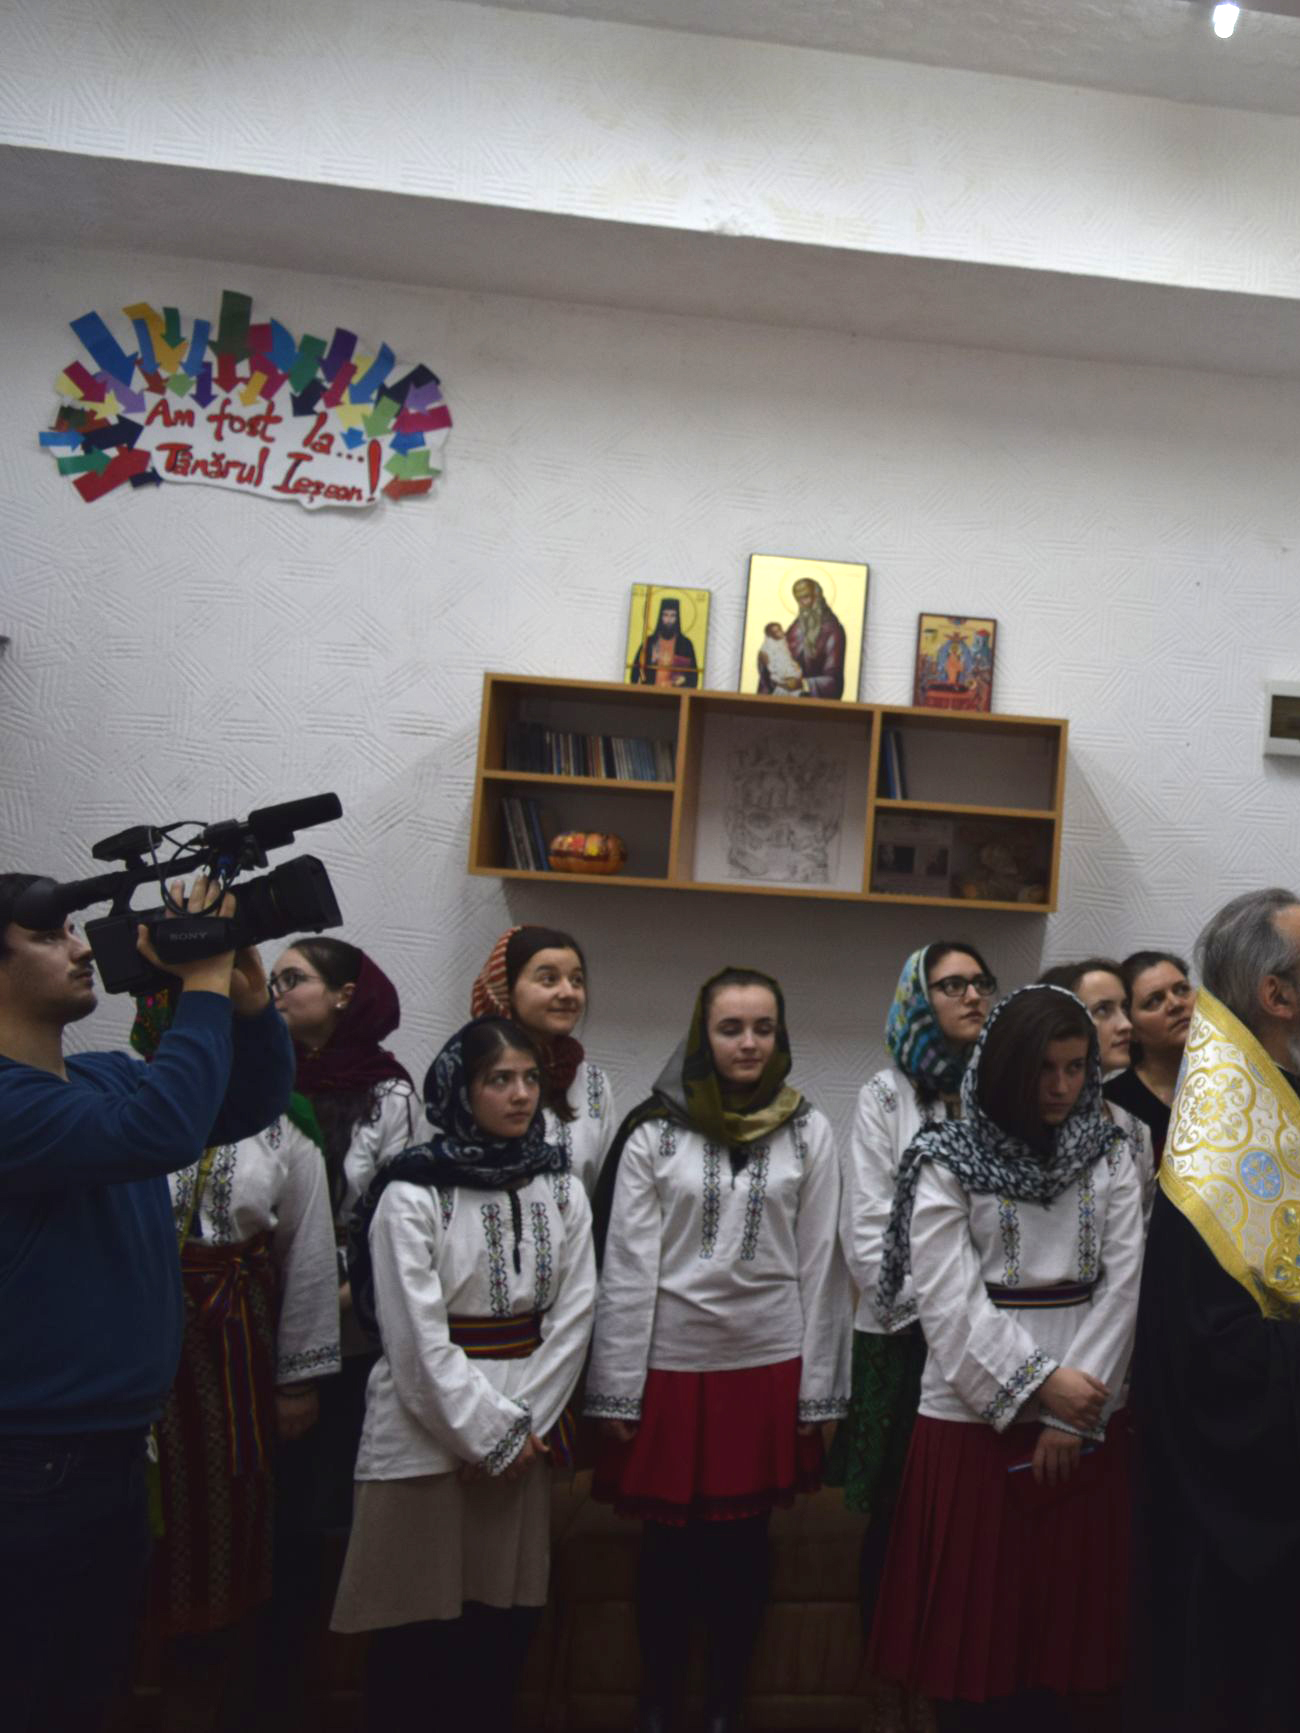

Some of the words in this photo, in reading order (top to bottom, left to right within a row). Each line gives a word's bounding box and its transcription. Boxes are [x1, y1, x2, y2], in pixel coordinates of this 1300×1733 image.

[144, 398, 196, 429] Am
[207, 398, 283, 443] fost
[169, 931, 208, 941] SONY
